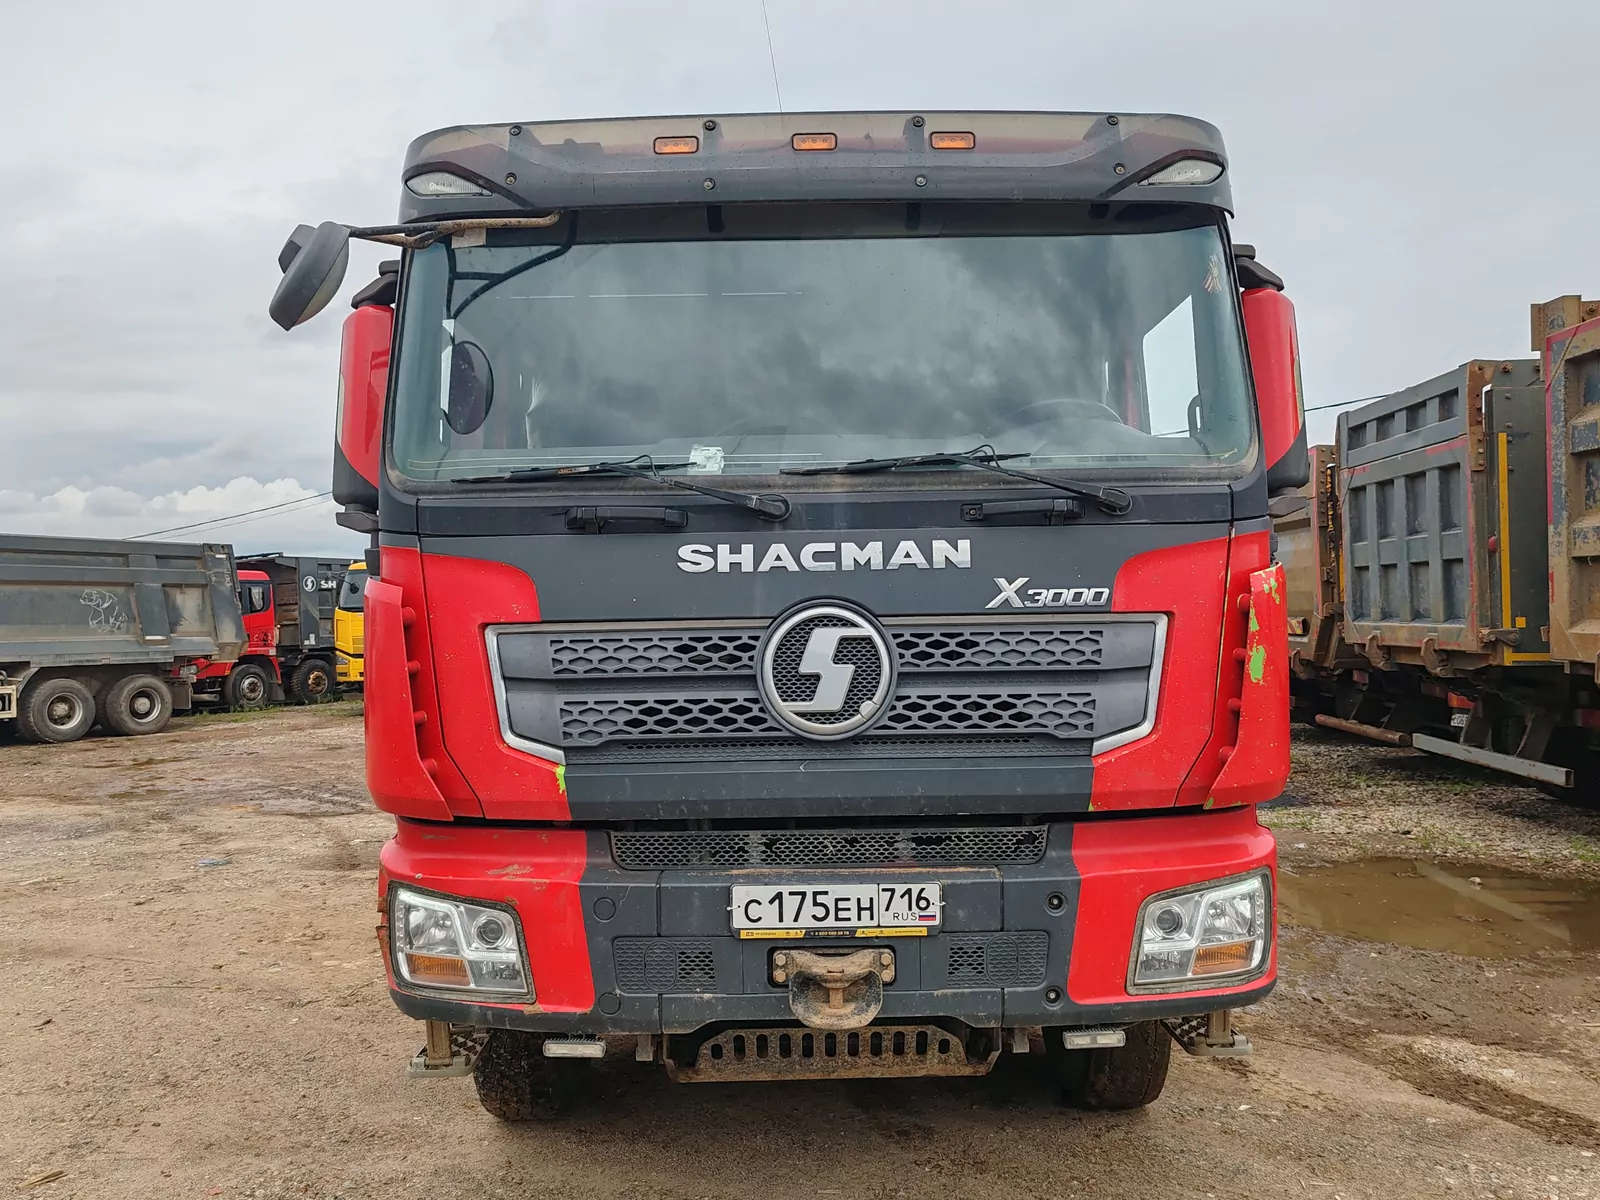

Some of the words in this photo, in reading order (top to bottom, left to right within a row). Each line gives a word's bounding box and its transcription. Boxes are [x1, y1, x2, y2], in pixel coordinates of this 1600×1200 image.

[677, 539, 971, 573] SHACMAN
[985, 577, 1110, 609] X3000
[881, 887, 931, 912] 716
[892, 912, 917, 921] RUS
